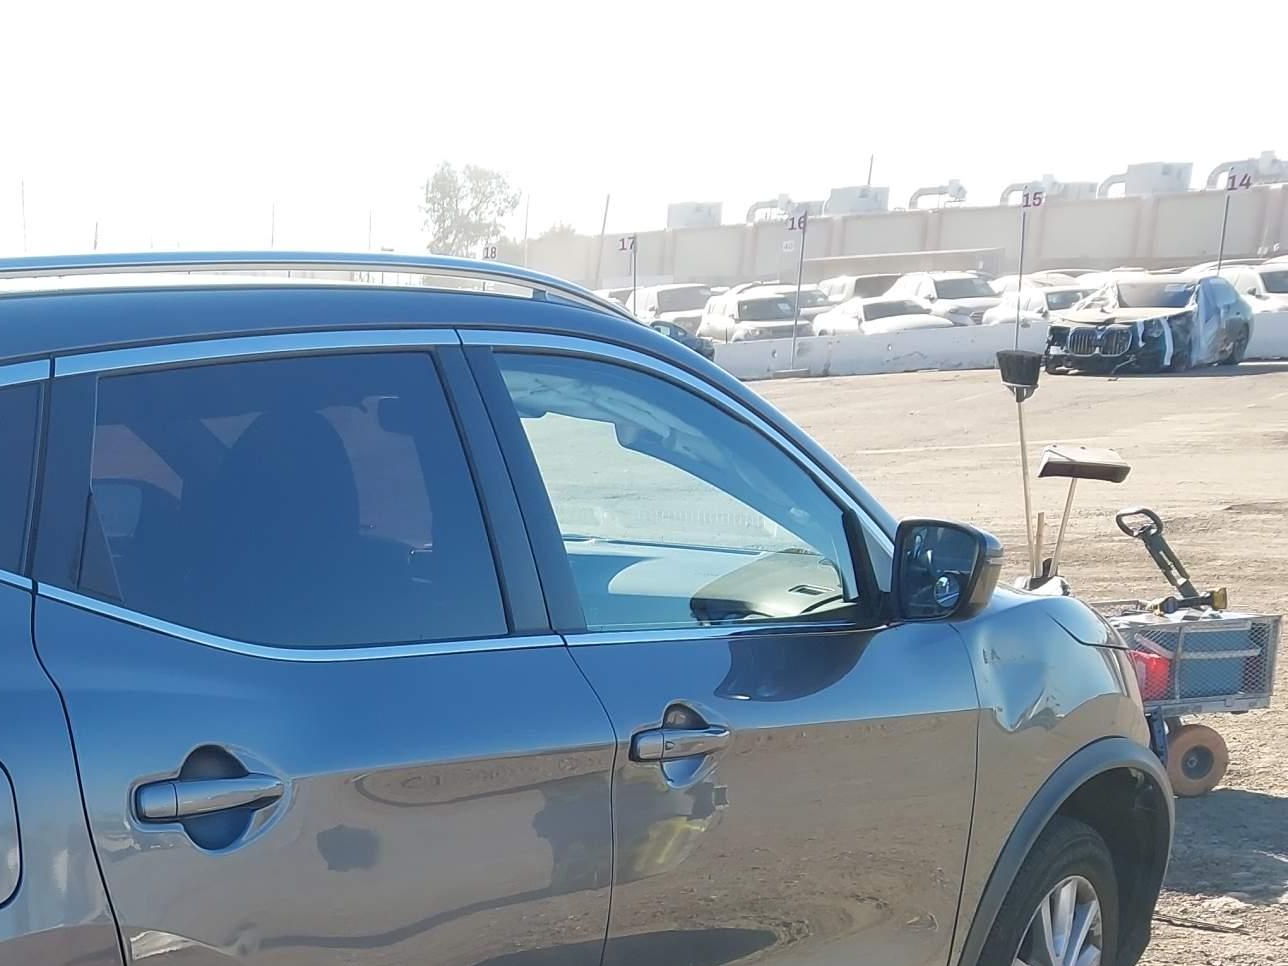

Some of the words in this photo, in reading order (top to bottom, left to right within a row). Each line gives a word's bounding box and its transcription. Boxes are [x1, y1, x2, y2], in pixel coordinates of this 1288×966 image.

[1227, 173, 1252, 191] 14
[1023, 191, 1043, 208] 15
[788, 215, 807, 231] 16
[618, 236, 636, 251] 17
[484, 247, 497, 259] 18
